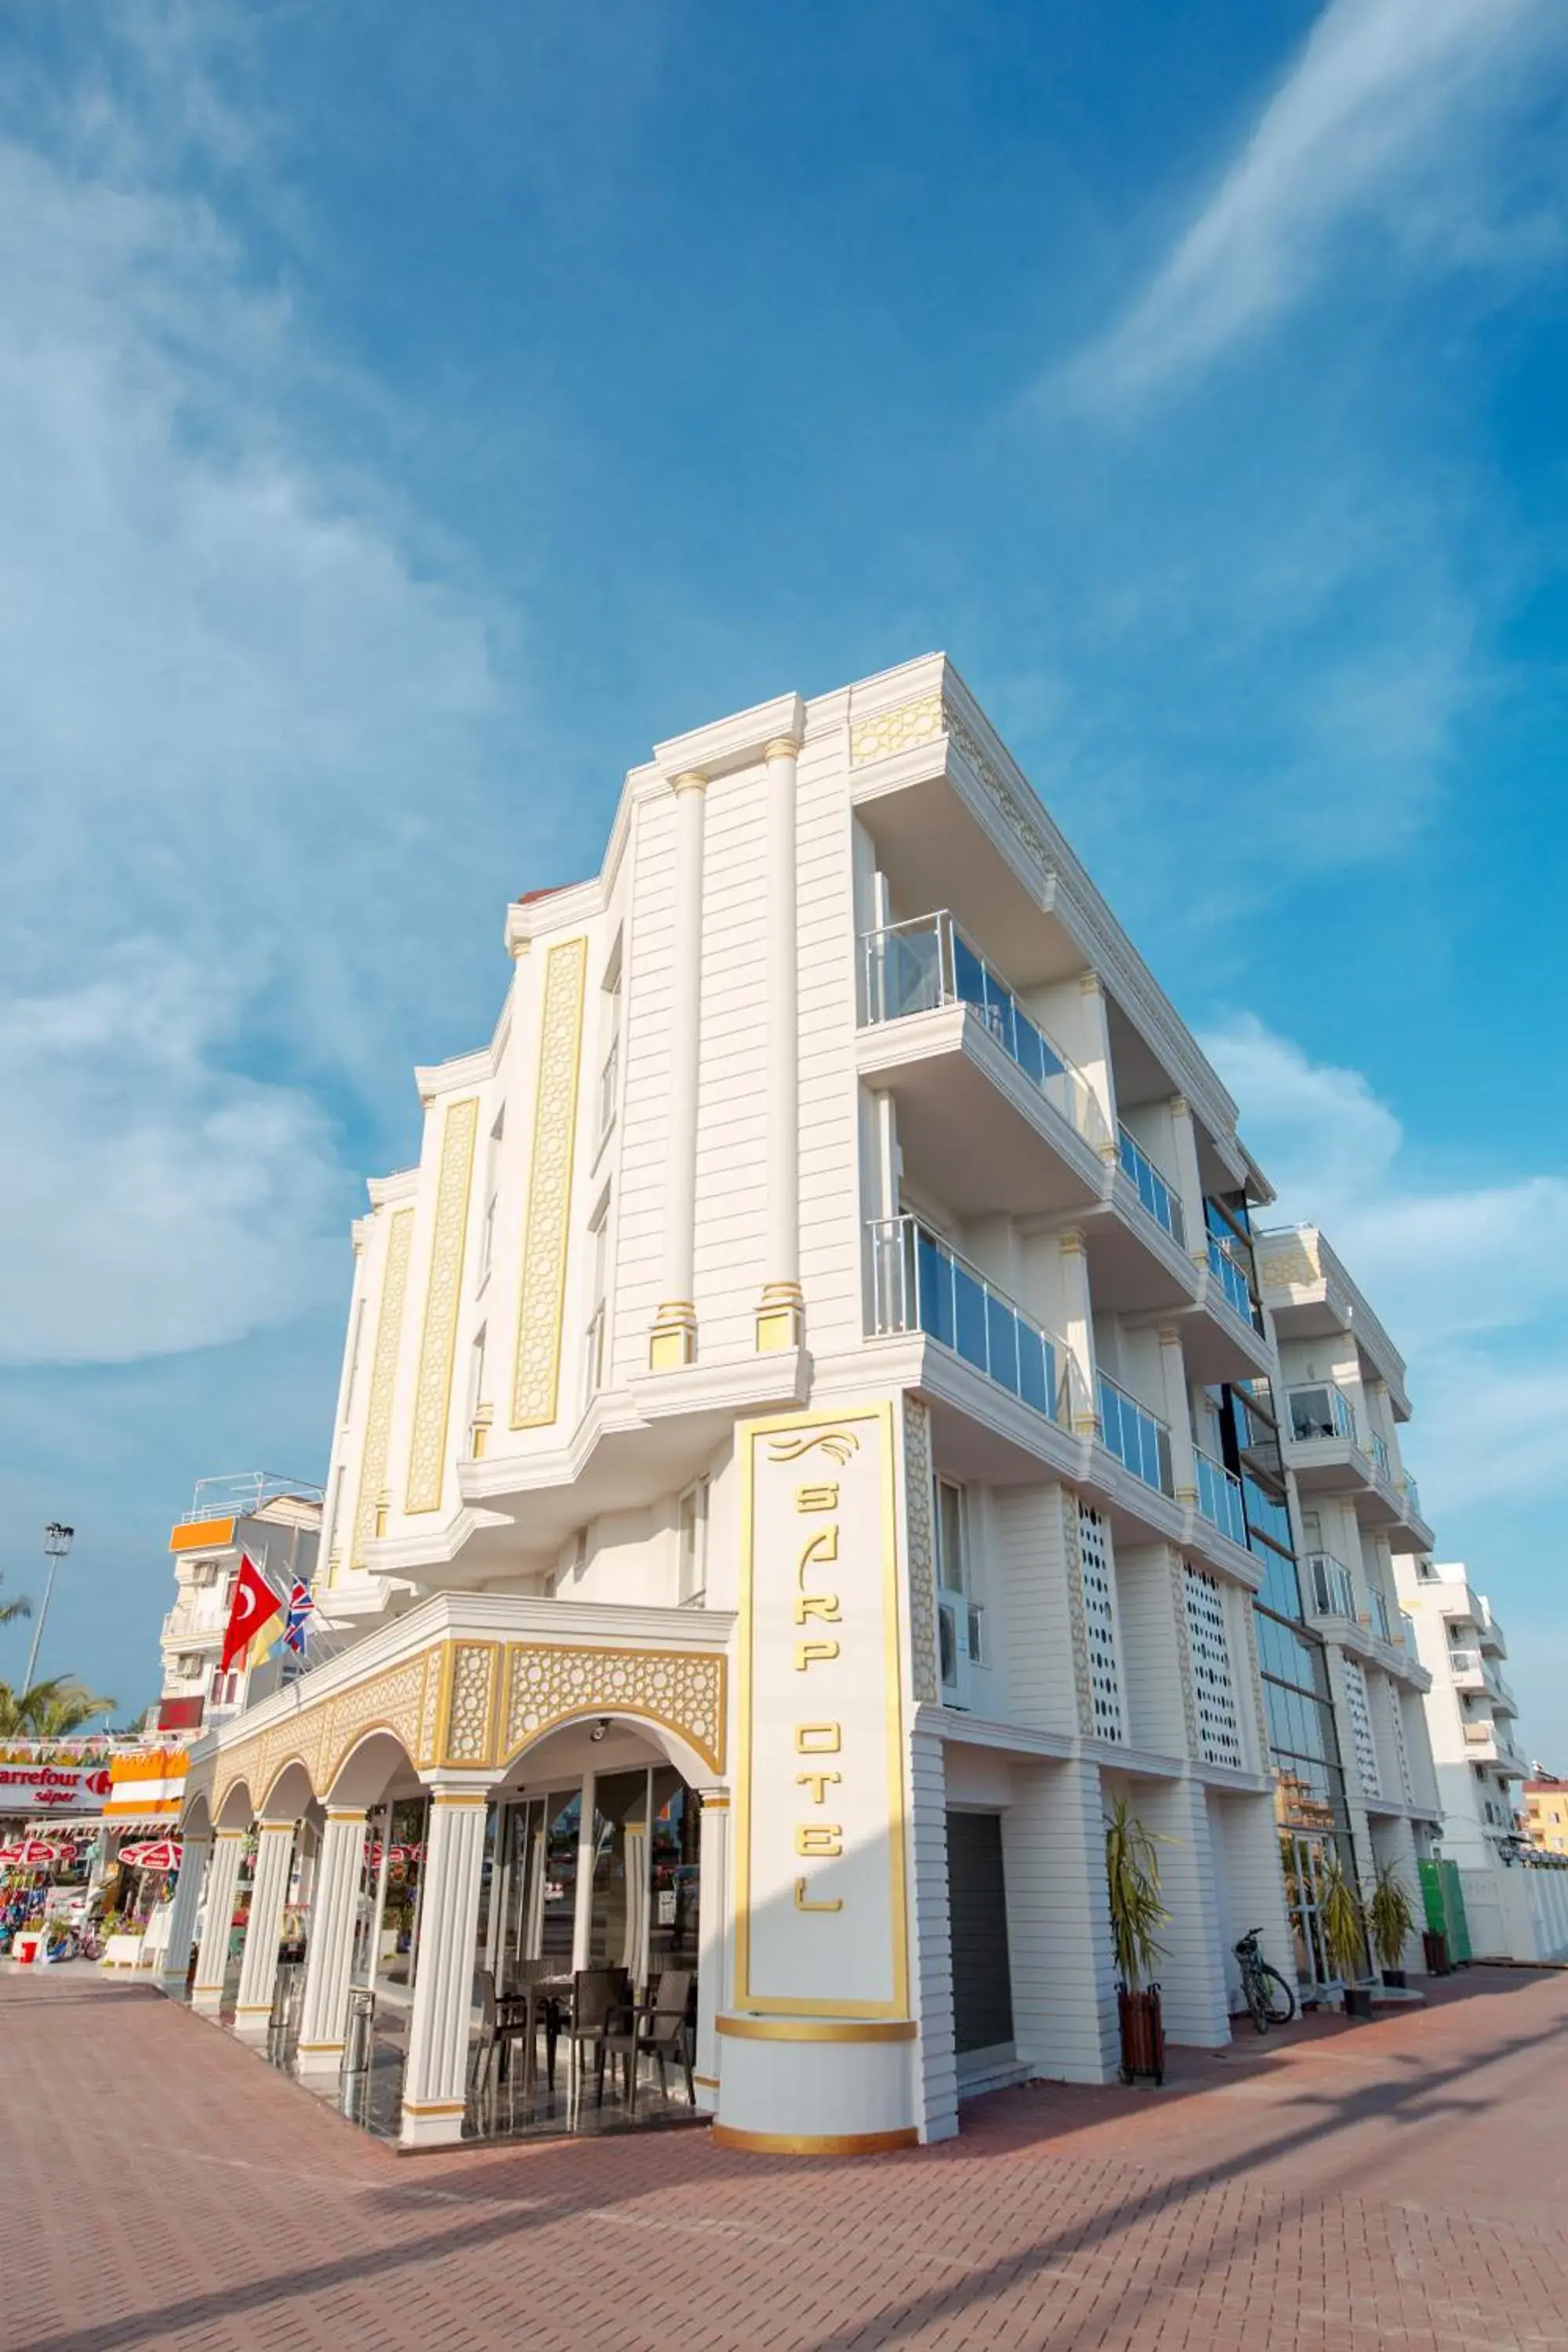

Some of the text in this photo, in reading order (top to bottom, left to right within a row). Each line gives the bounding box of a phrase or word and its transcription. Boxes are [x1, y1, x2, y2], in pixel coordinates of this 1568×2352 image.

[0, 1767, 81, 1786] arrefour
[794, 1481, 843, 1911] SARP OTEL
